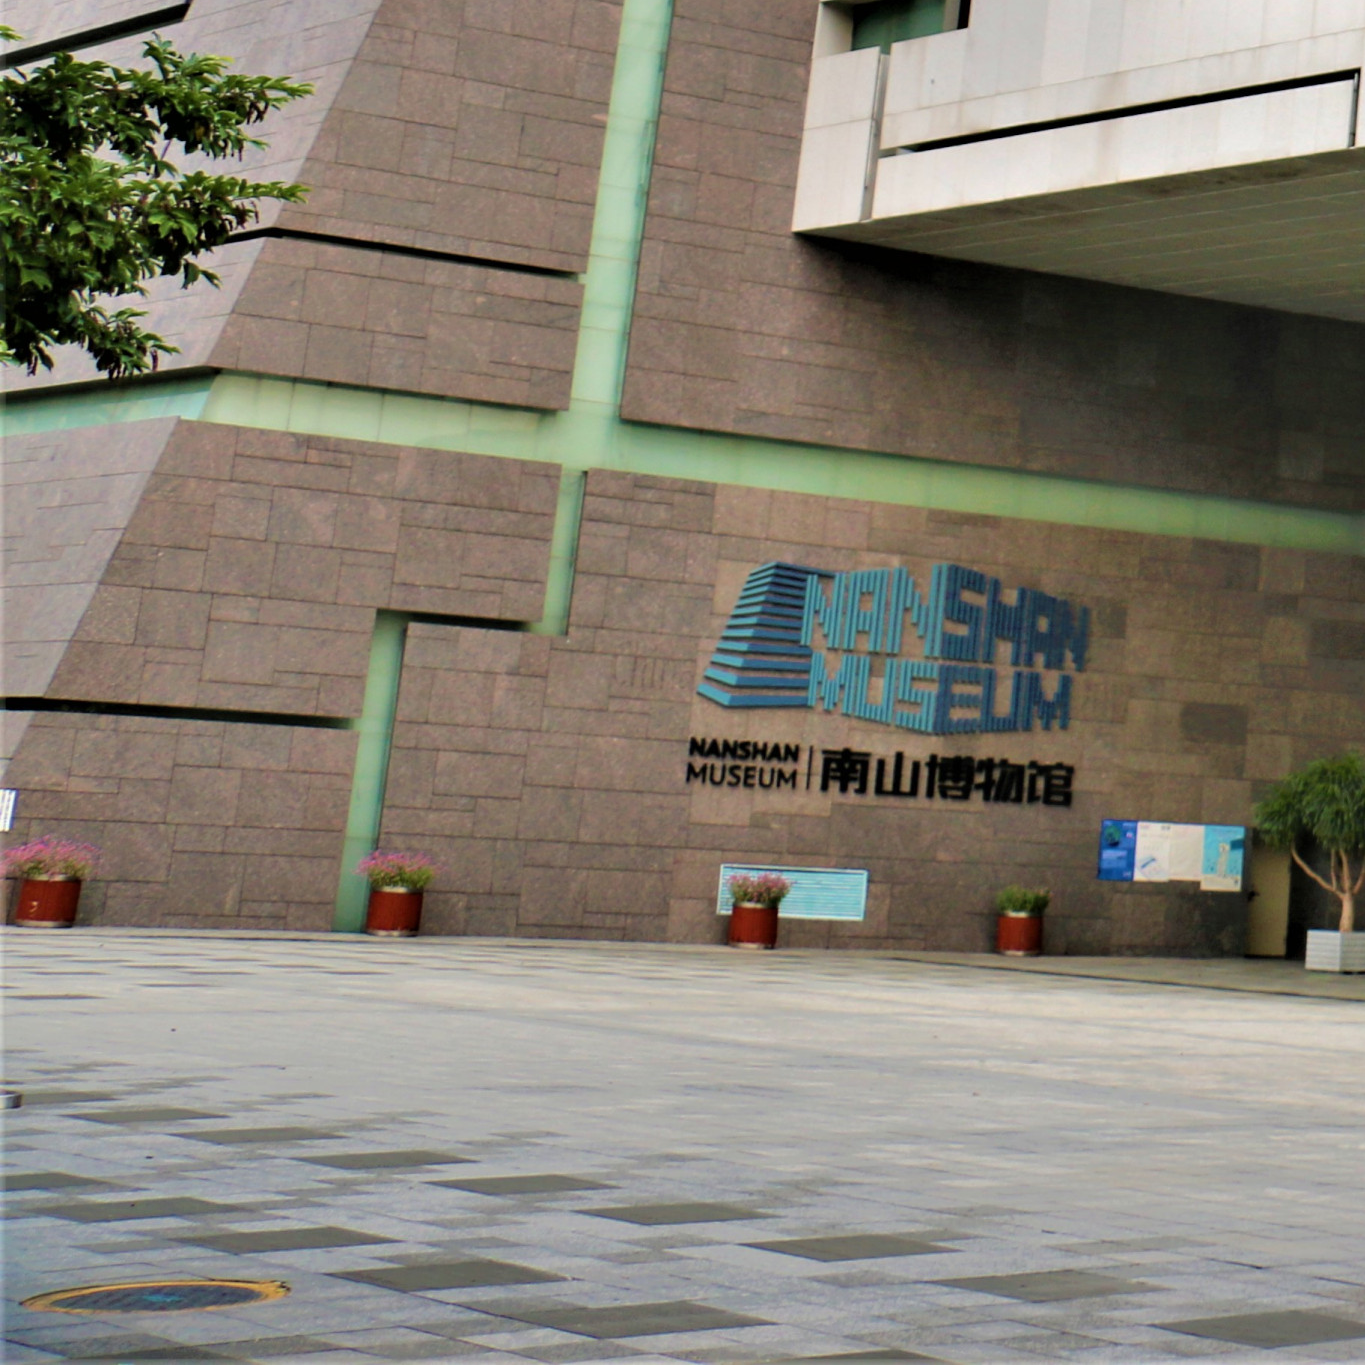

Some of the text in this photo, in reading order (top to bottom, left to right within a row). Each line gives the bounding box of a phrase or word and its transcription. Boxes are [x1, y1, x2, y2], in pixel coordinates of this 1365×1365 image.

[801, 563, 1091, 673] NANSHAN
[805, 651, 1073, 735] MUSEUM
[686, 762, 798, 790] MUSEUM
[689, 736, 800, 763] NANSHAN
[820, 747, 1076, 808] 南山博物馆
